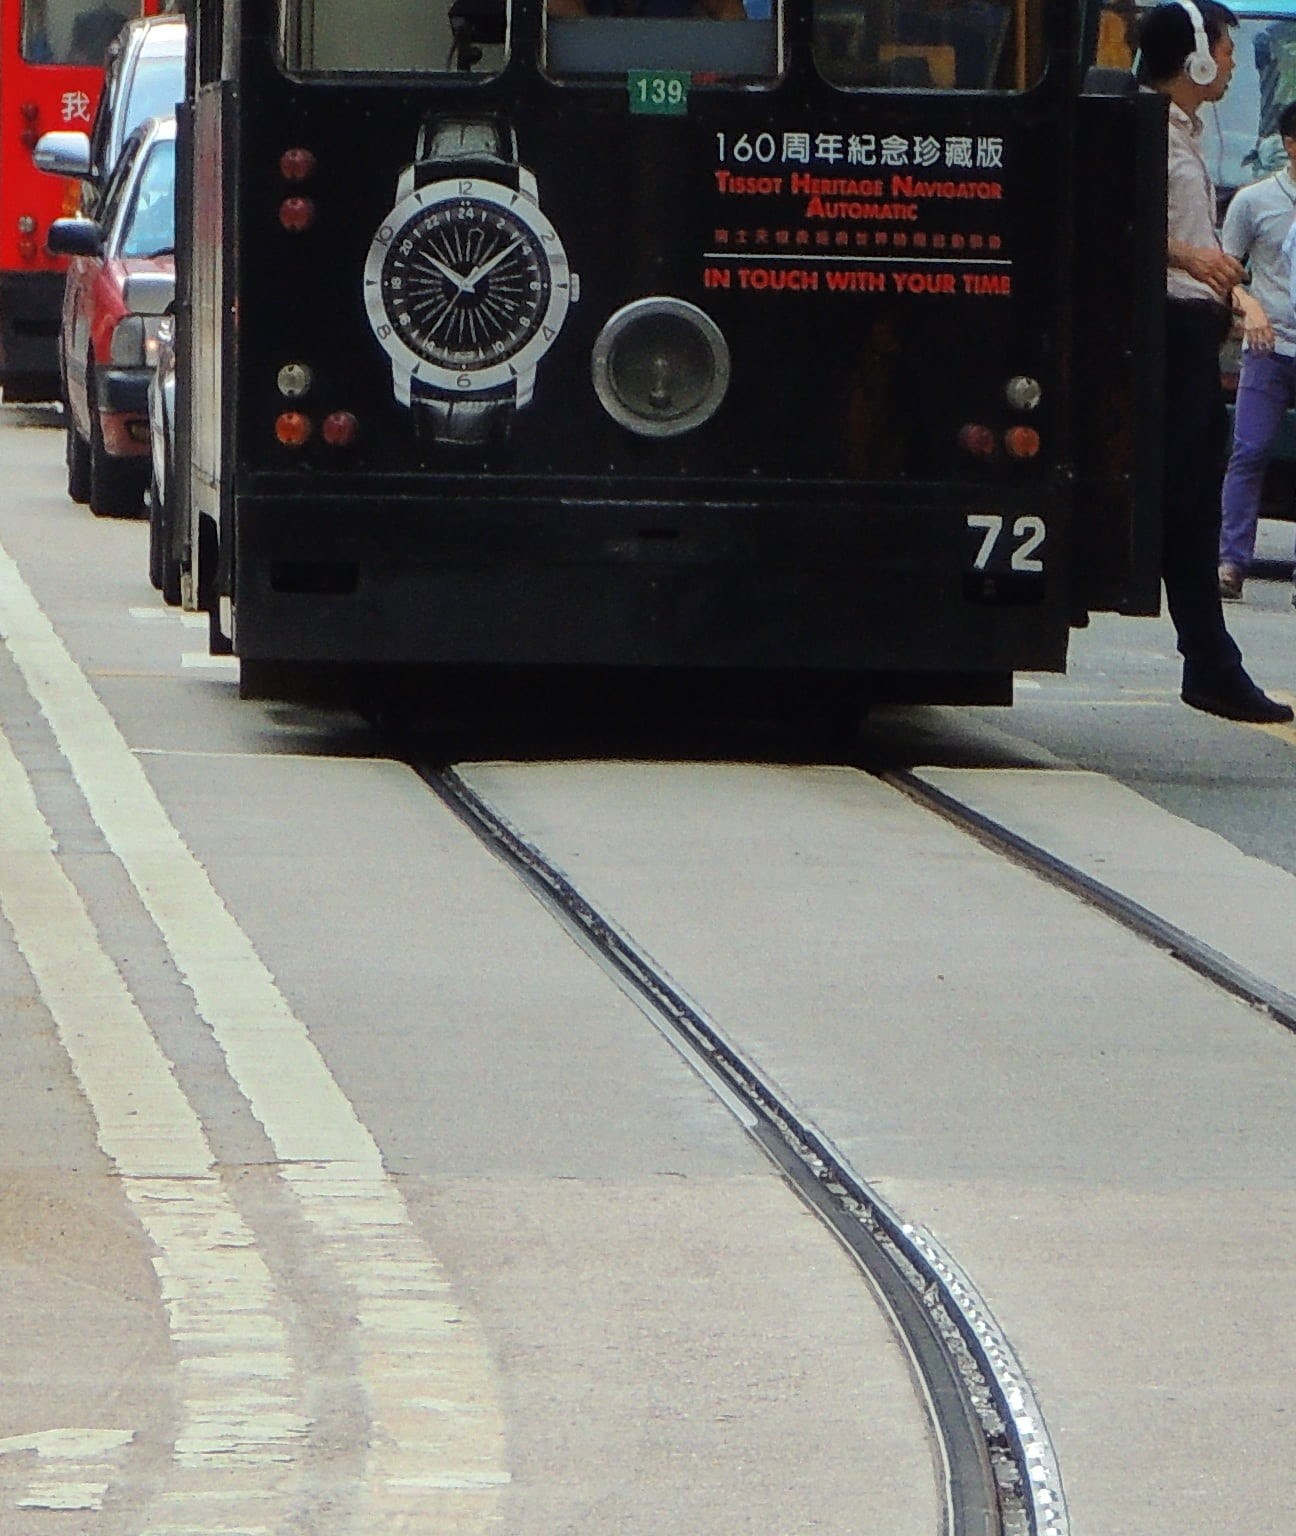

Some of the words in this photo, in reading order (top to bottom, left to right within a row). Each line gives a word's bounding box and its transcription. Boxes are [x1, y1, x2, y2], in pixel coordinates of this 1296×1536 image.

[637, 78, 682, 104] 139
[715, 132, 1004, 168] 160周年紀念珍藏版
[458, 181, 473, 195] 12
[704, 268, 730, 288] IN
[738, 269, 818, 290] TOUCH
[826, 272, 885, 292] WITH
[893, 273, 955, 293] YOUR
[963, 275, 1010, 295] TIME
[967, 515, 1046, 572] 72
